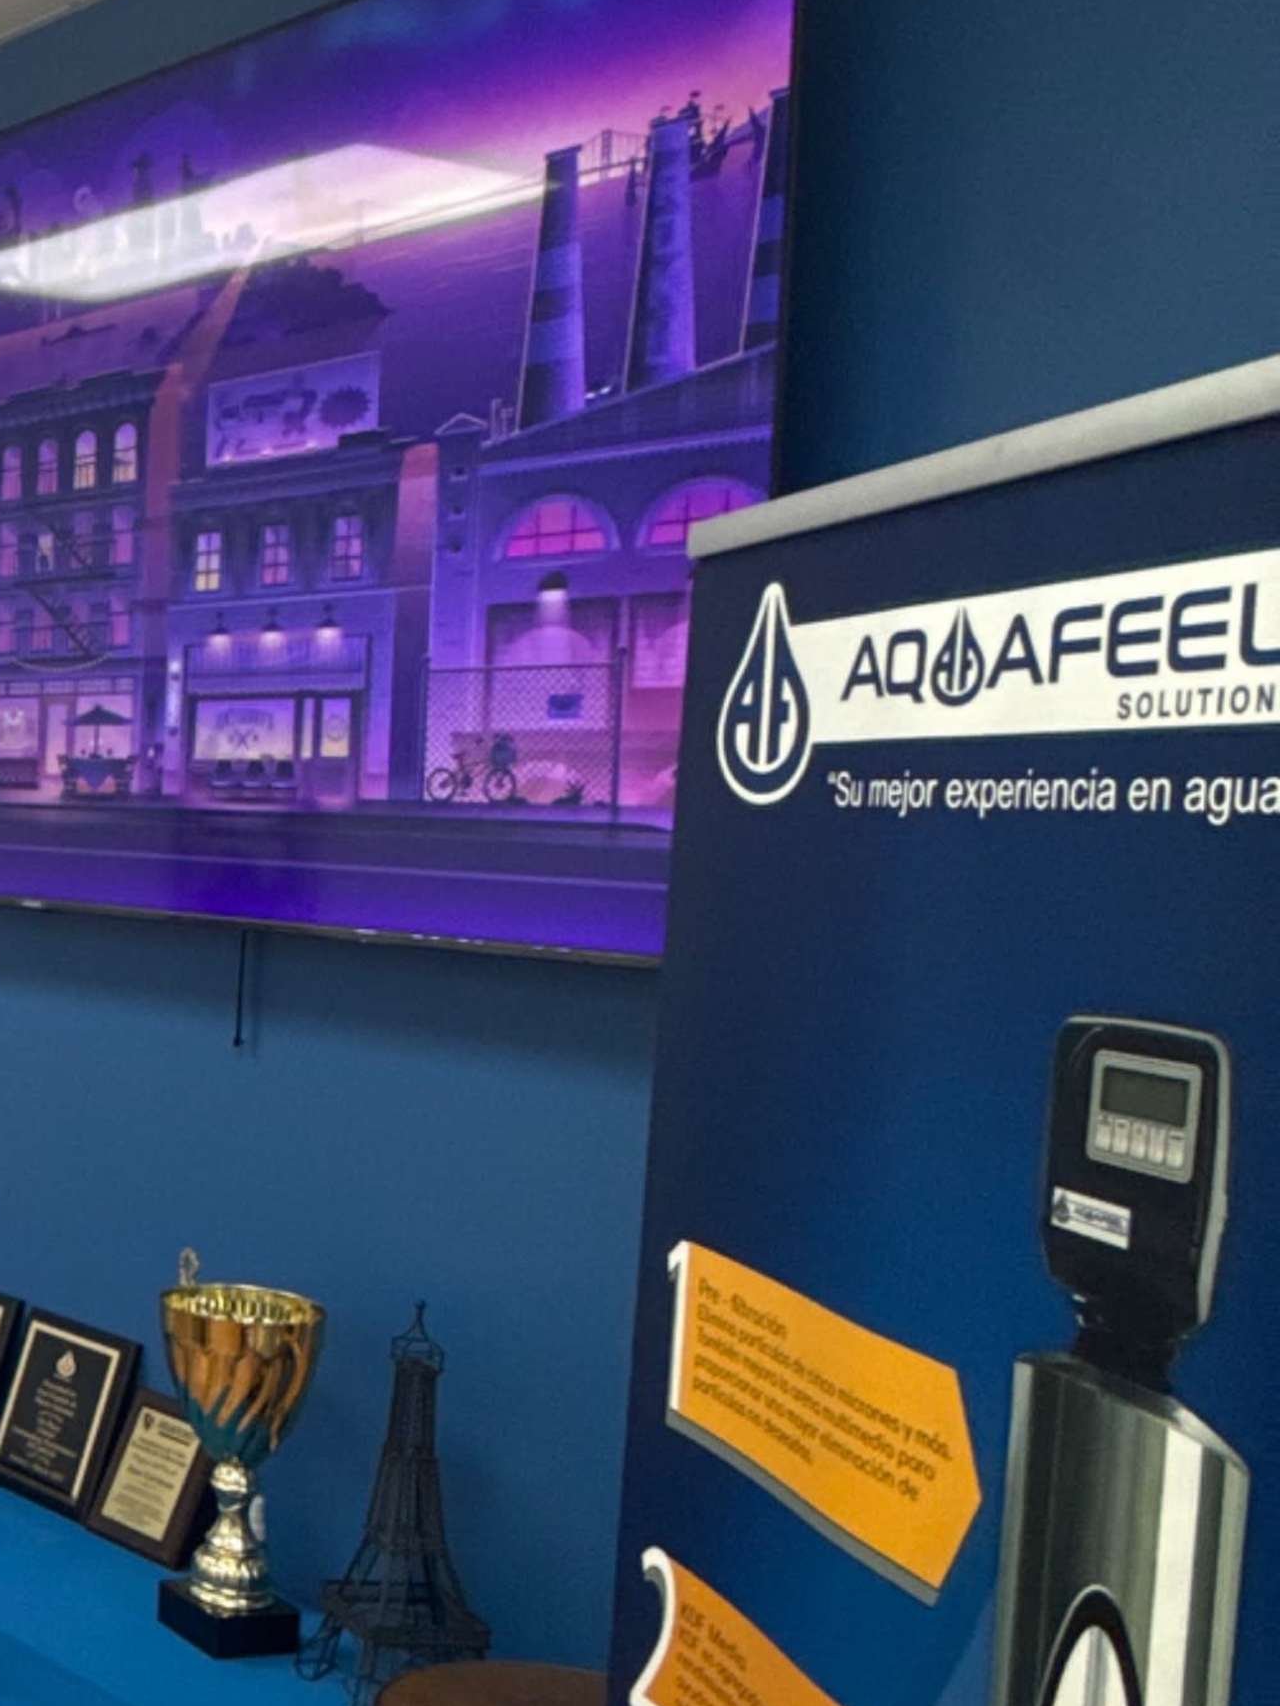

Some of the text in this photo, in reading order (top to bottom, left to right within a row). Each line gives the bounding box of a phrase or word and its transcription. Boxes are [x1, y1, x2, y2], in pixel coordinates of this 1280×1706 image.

[868, 770, 938, 818] mejor
[945, 769, 1117, 818] experiencia
[1127, 776, 1172, 811] en
